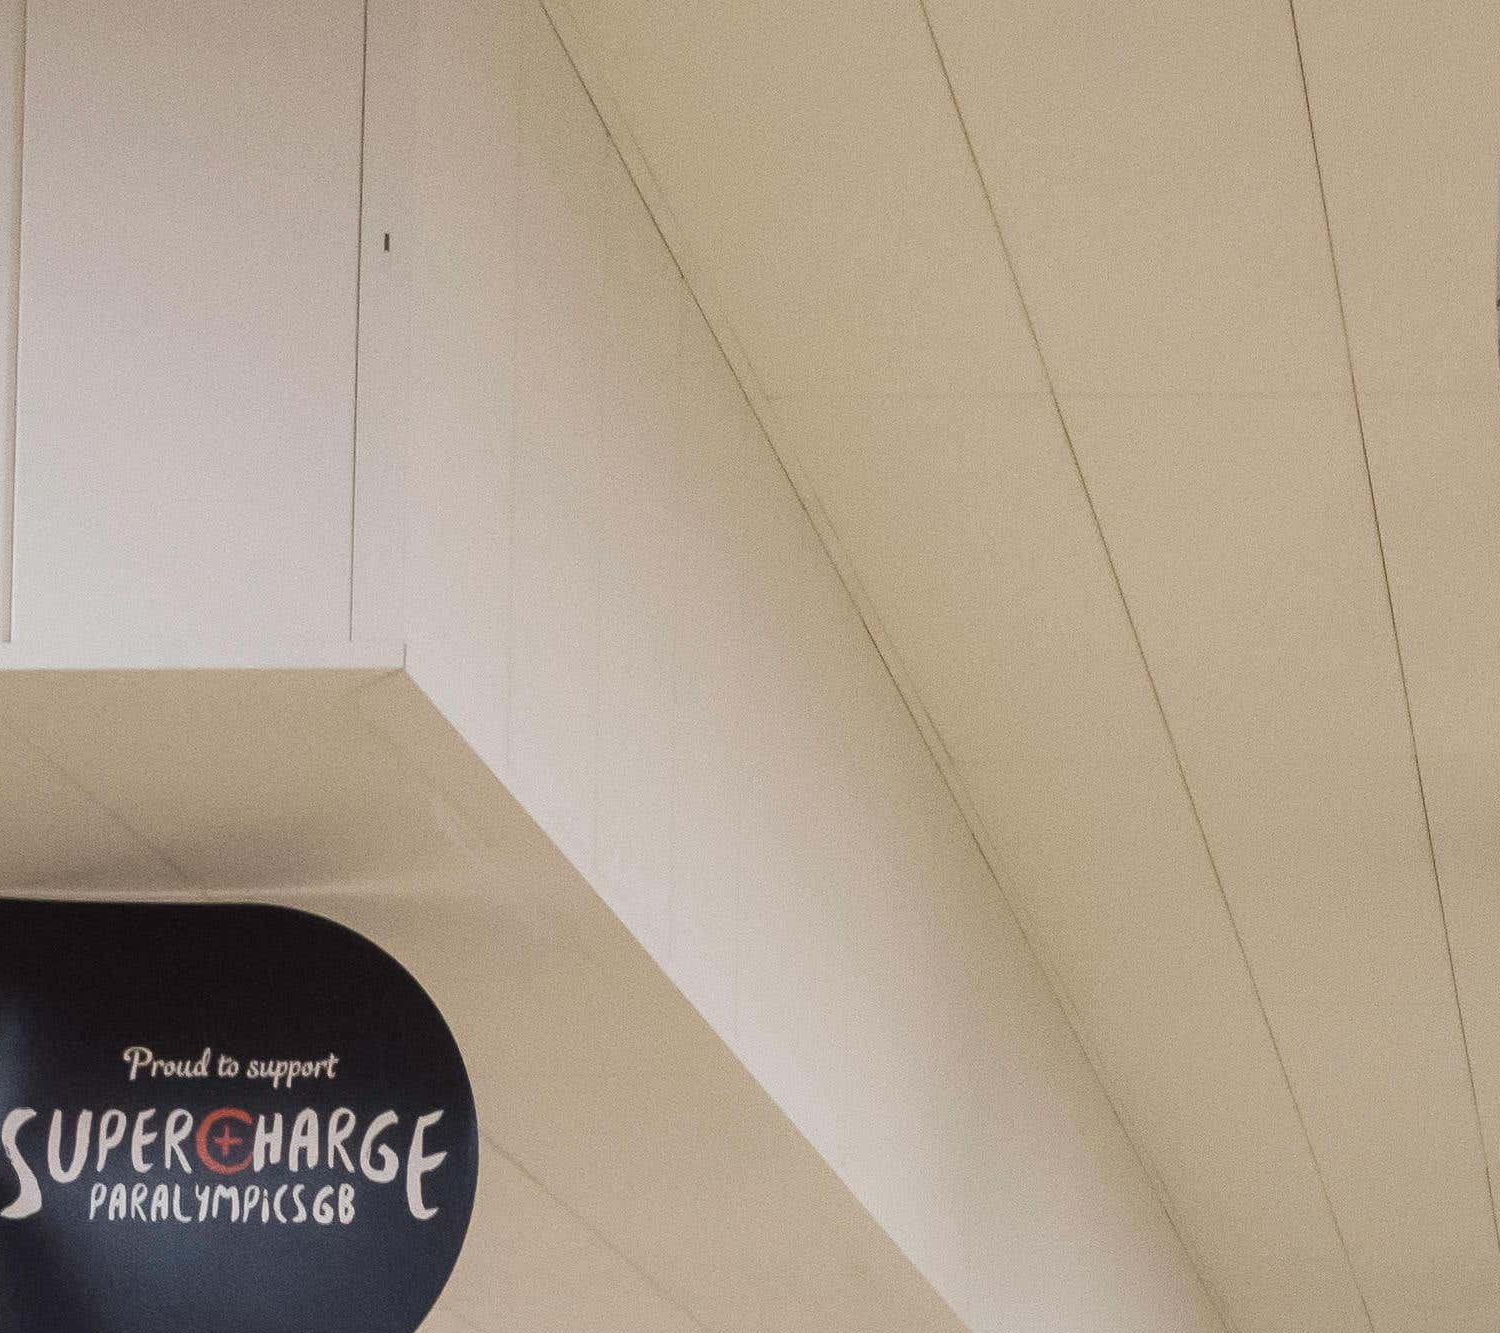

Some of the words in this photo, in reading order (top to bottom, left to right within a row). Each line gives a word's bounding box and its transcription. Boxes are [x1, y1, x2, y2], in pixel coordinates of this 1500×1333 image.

[123, 1045, 210, 1081] Proud
[217, 1053, 242, 1081] to
[247, 1050, 338, 1087] support
[1, 1107, 445, 1220] SUPERCHARGE
